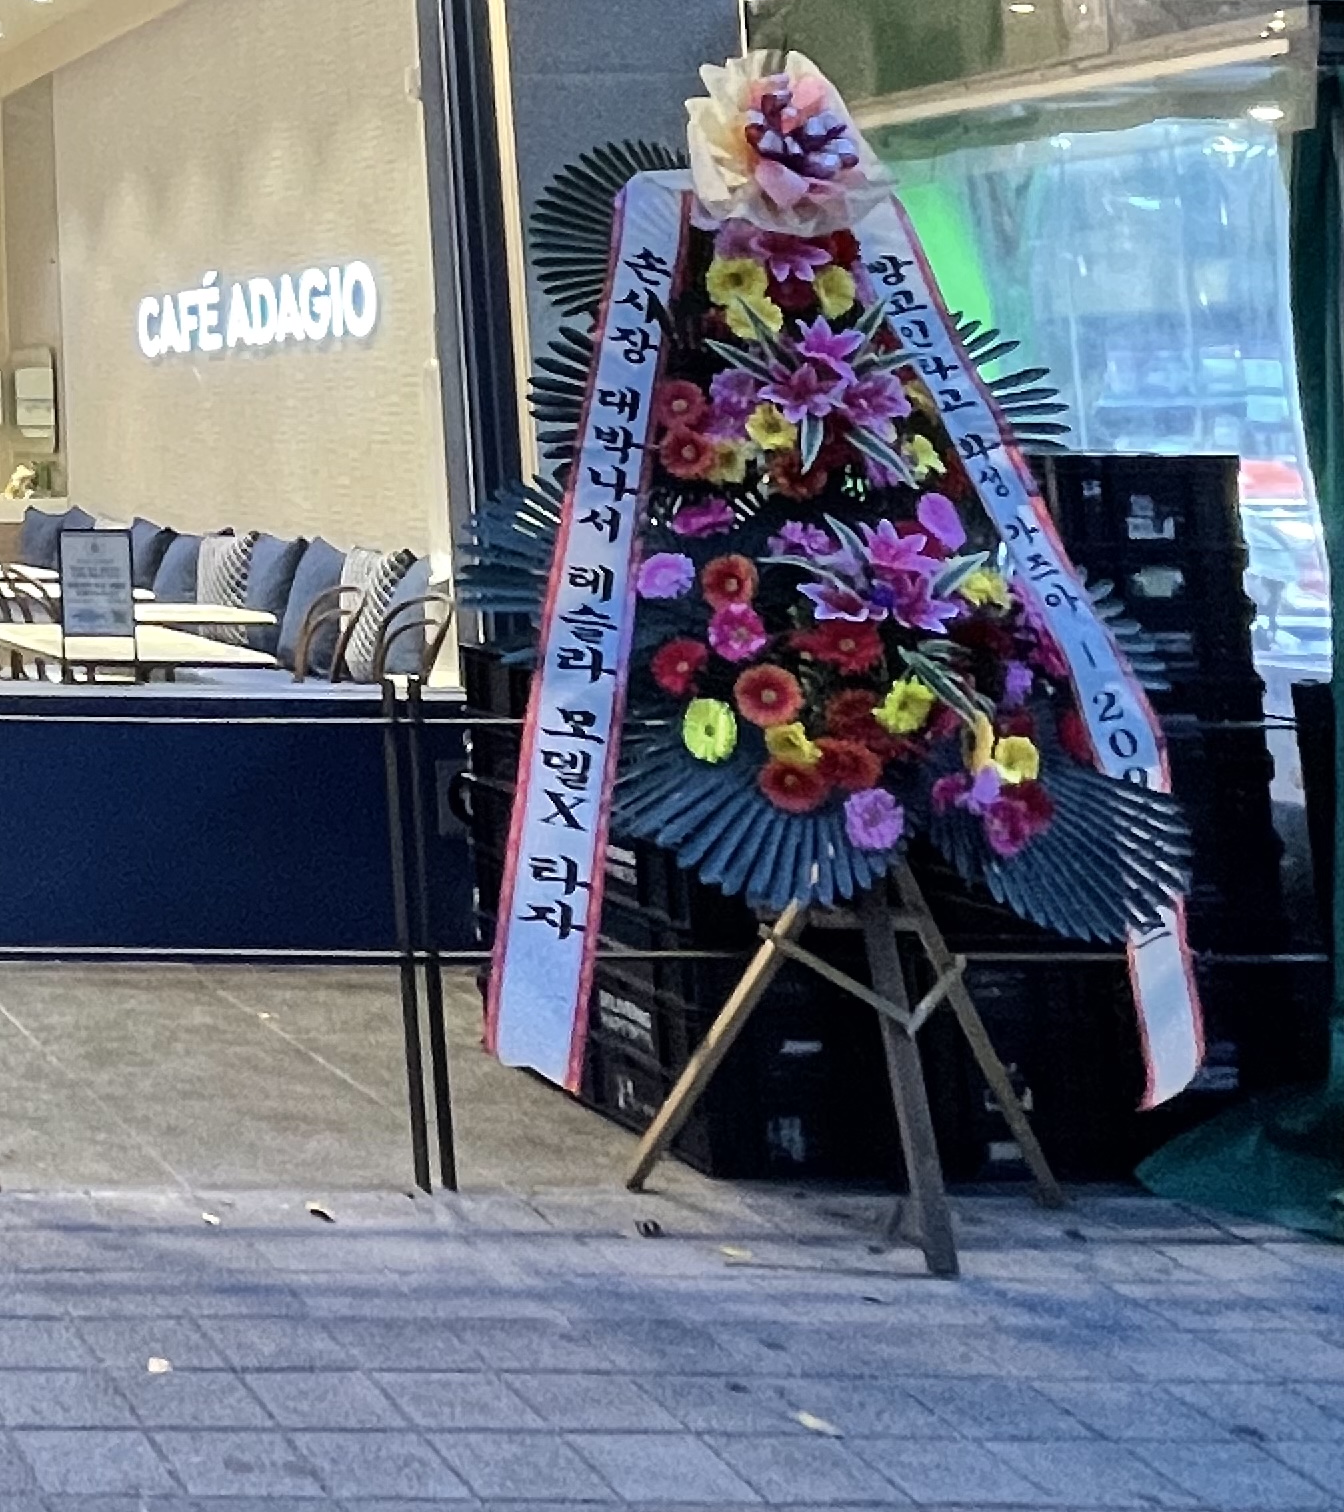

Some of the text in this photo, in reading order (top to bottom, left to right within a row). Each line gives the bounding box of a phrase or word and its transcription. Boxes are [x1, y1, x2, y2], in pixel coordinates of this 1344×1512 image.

[138, 260, 378, 358] CAFÉ ADAGIO
[577, 386, 644, 544] 대박나서
[1004, 516, 1080, 612] 가즈아
[556, 564, 618, 684] 테슬라
[539, 706, 606, 833] 모델X
[517, 854, 593, 941] 타자
